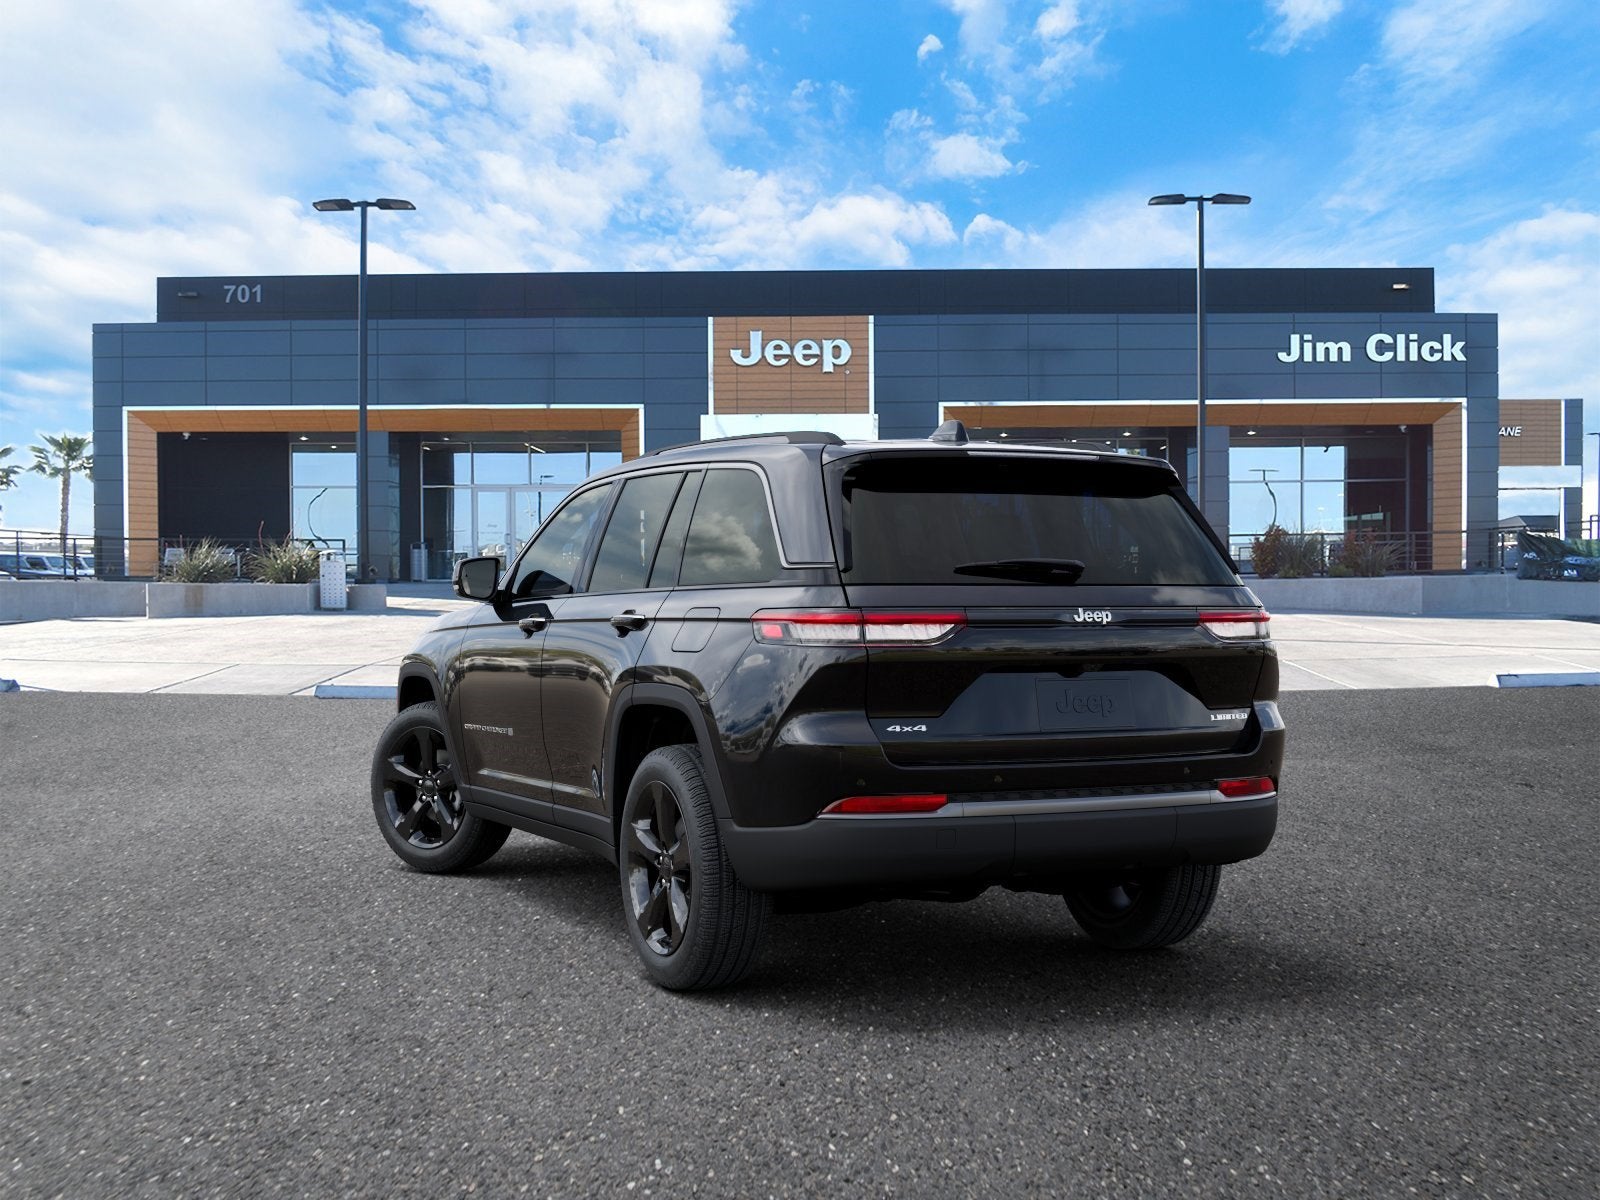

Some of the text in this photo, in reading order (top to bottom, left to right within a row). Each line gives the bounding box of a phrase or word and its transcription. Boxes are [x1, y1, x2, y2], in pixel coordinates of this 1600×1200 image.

[223, 284, 262, 304] 701
[729, 329, 852, 374] Jeep
[1277, 333, 1467, 363] Jim Click
[1073, 607, 1112, 625] Jeep
[1055, 688, 1113, 718] Jeep
[886, 724, 927, 732] 4x4
